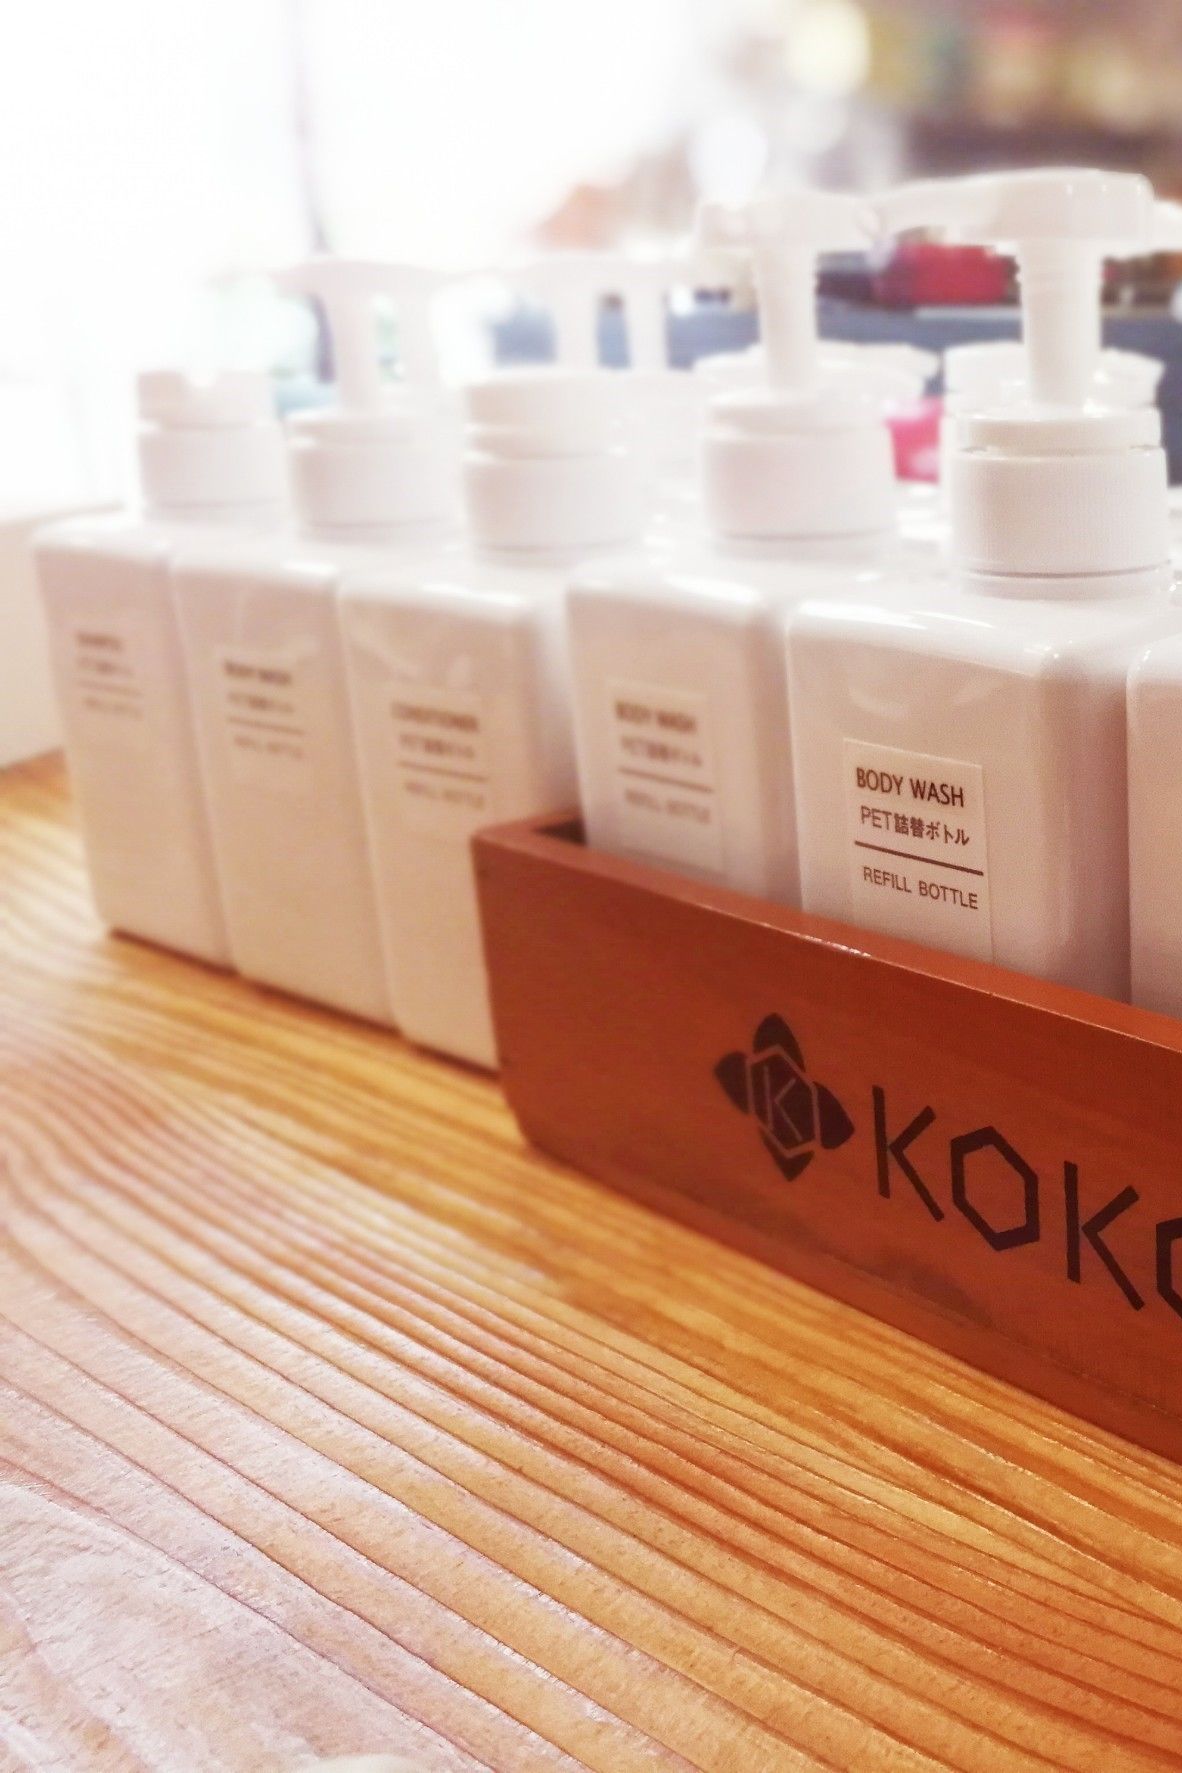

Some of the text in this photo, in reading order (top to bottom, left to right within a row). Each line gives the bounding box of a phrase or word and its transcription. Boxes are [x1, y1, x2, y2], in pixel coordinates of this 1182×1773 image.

[856, 767, 965, 808] BODY WASH
[860, 805, 970, 846] PET詰替ボトル
[863, 866, 979, 910] REFILL BOTTLE
